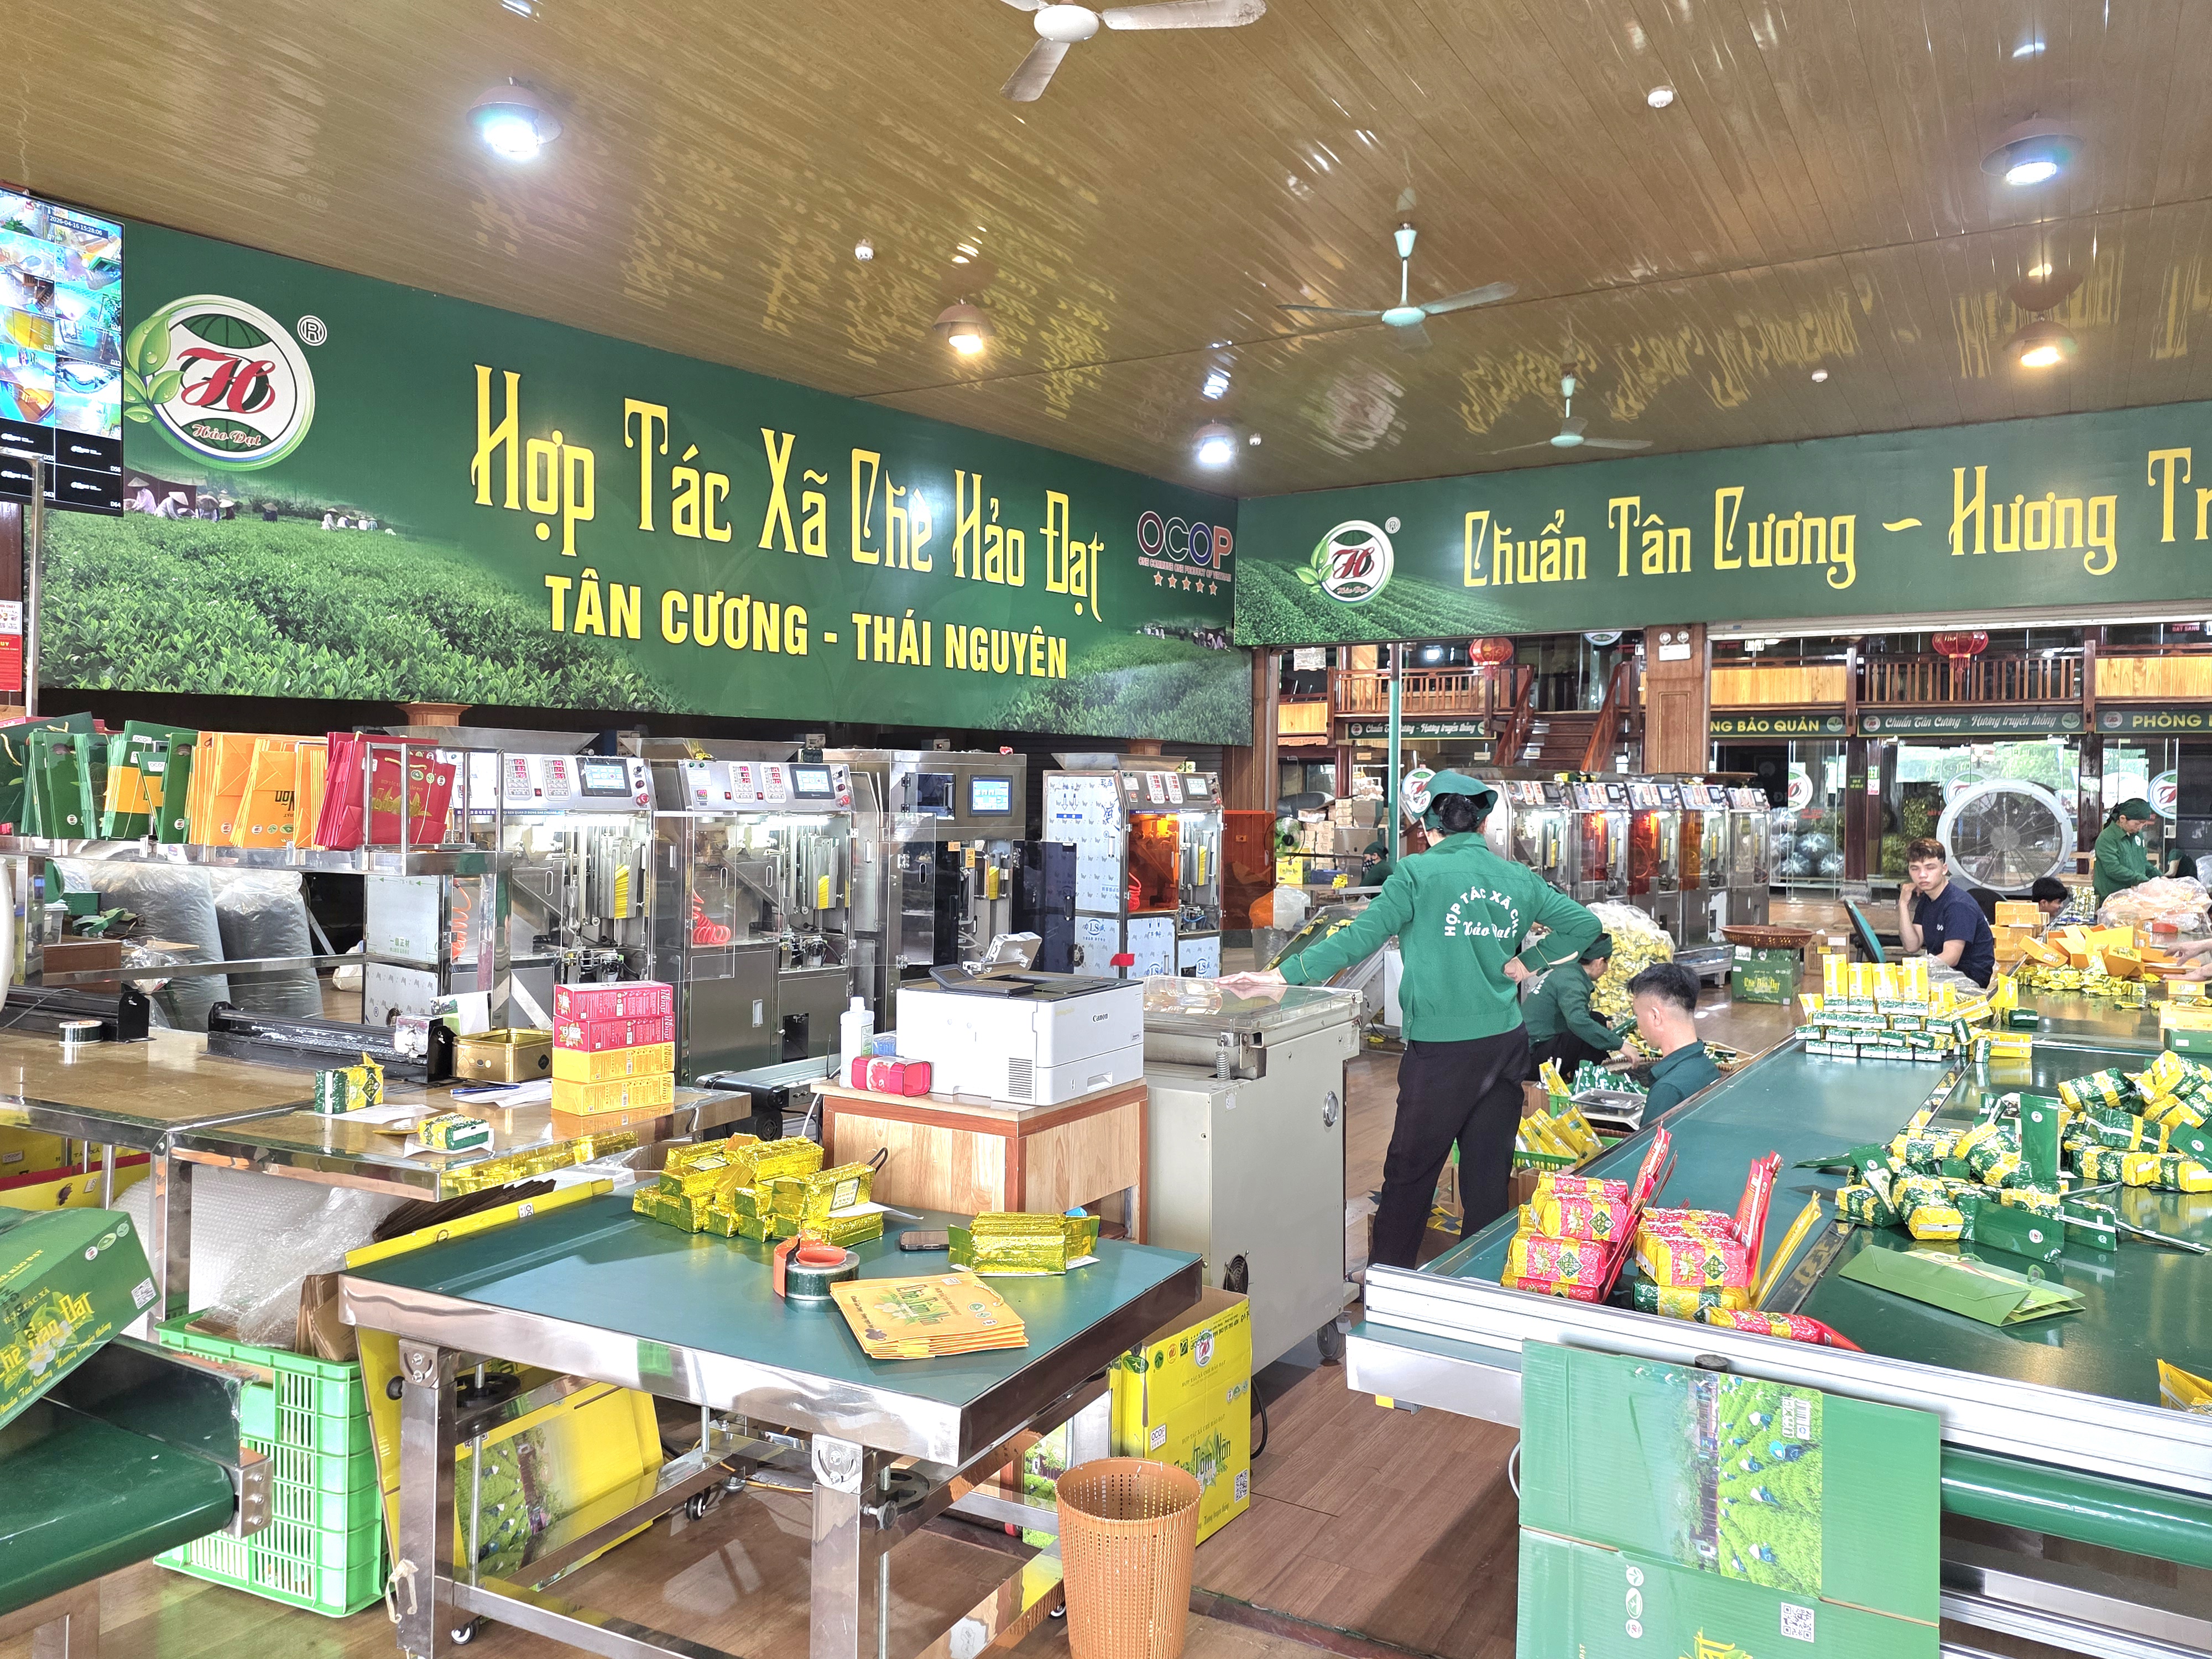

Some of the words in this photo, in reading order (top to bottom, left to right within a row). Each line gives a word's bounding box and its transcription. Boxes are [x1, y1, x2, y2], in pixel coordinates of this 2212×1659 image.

[471, 364, 595, 557] Hợp
[624, 397, 732, 543] Tác
[758, 427, 828, 559] Xã
[851, 447, 933, 573] Chè
[952, 468, 1026, 588] Hảo
[1039, 489, 1105, 624] Đạt
[1137, 510, 1234, 570] OCOP
[1463, 508, 1587, 588] Chuẩn
[1608, 495, 1691, 578] Tân
[1713, 486, 1856, 589] Cương
[1948, 465, 2118, 576] Hương
[544, 567, 641, 640] TÂN
[660, 589, 808, 656] CƯƠNG
[852, 609, 932, 667] THÁI
[945, 624, 1068, 680] NGUYÊN
[1737, 716, 1770, 733] BẢO
[1773, 716, 1819, 732] QUẢN
[2132, 711, 2202, 728] PHÒNG
[1444, 902, 1462, 937] HỢP
[1459, 886, 1486, 904] TÁC
[1489, 890, 1512, 910] XÃ
[1091, 1012, 1109, 1023] Canon
[58, 1291, 96, 1324] Đạt
[1151, 1426, 1165, 1441] OCOP
[1194, 1446, 1212, 1479] Tôm
[1216, 1432, 1231, 1462] Nõn
